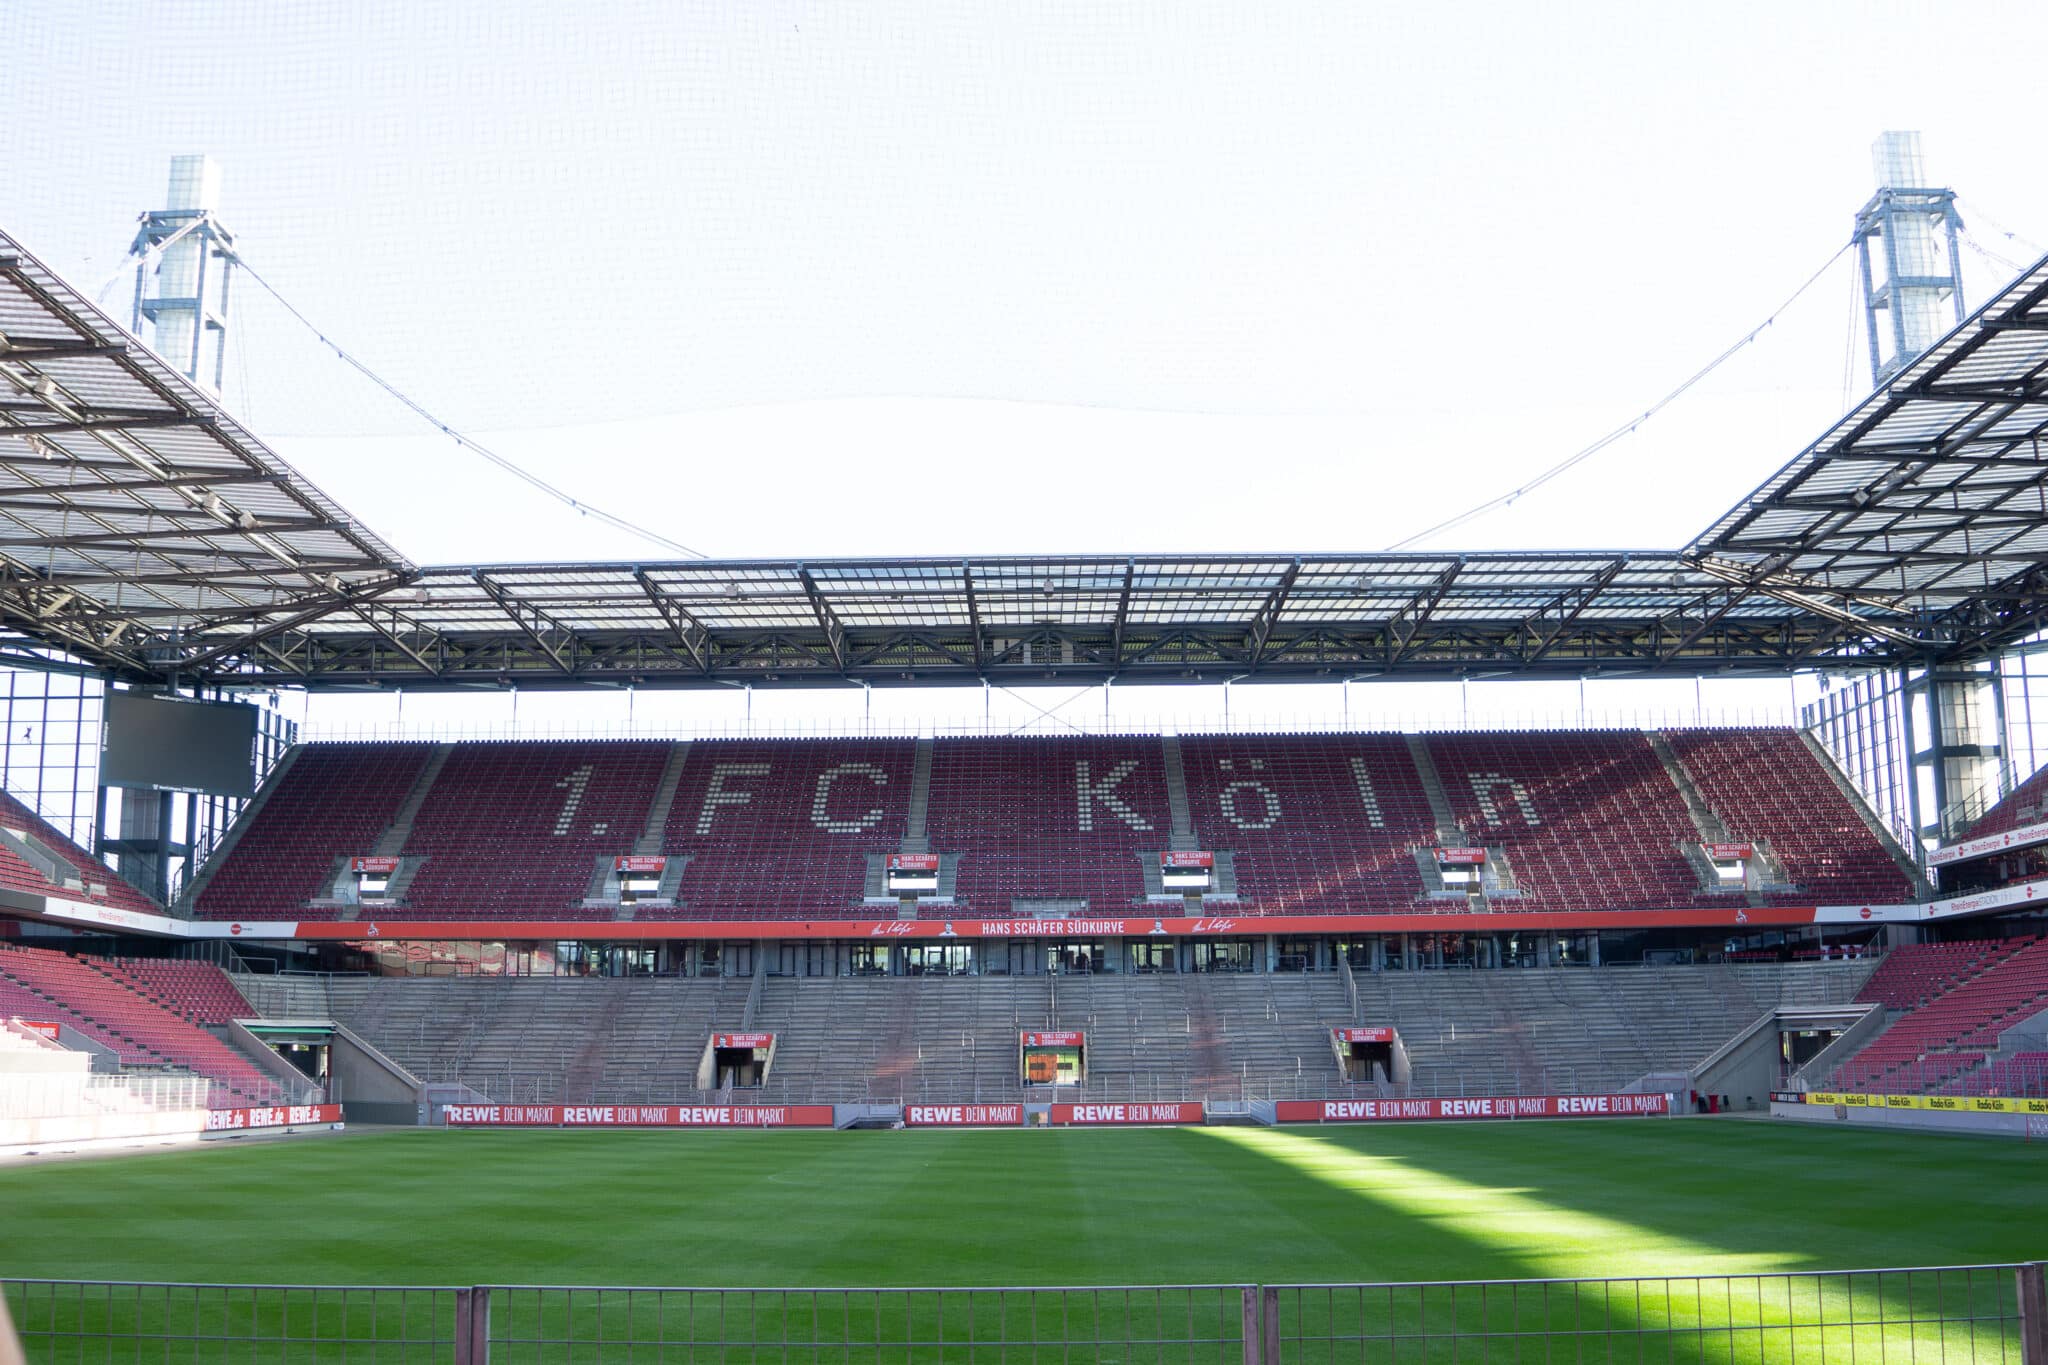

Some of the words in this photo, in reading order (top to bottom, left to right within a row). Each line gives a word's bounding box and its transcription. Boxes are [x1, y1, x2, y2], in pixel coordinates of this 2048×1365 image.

[553, 765, 607, 834] 1.
[982, 922, 1011, 934] HANS
[1014, 920, 1064, 934] SCHÄFER
[1067, 920, 1124, 934] SÜDKURVE
[1325, 1102, 1376, 1117] REWE
[1380, 1102, 1400, 1116] DEIN
[1403, 1100, 1431, 1116] MARKT
[1441, 1100, 1492, 1115] REWE
[1496, 1099, 1516, 1114] DEIN
[1518, 1098, 1546, 1114] MARKT
[1557, 1097, 1608, 1112] REWE
[1612, 1096, 1632, 1112] DEIN
[1634, 1095, 1662, 1112] MARKT
[1976, 1099, 1992, 1110] Radio
[2028, 1101, 2044, 1112] Radio
[206, 1109, 244, 1130] REWE.de
[250, 1107, 284, 1128] REWE.de
[288, 1105, 320, 1124] REWE.de
[450, 1107, 500, 1122] REWE
[504, 1107, 523, 1122] DEIN
[526, 1107, 554, 1122] MARKT
[564, 1108, 614, 1122] REWE
[618, 1108, 638, 1122] DEIN
[640, 1108, 668, 1122] MARKT
[680, 1108, 730, 1122] REWE
[734, 1108, 754, 1124] DEIN
[757, 1108, 785, 1124] MARKT
[910, 1107, 962, 1122] REWE
[966, 1106, 986, 1122] DEIN
[989, 1106, 1017, 1122] MARKT
[1073, 1105, 1125, 1120] REWE
[1128, 1105, 1148, 1120] DEIN
[1152, 1104, 1180, 1120] MARKT
